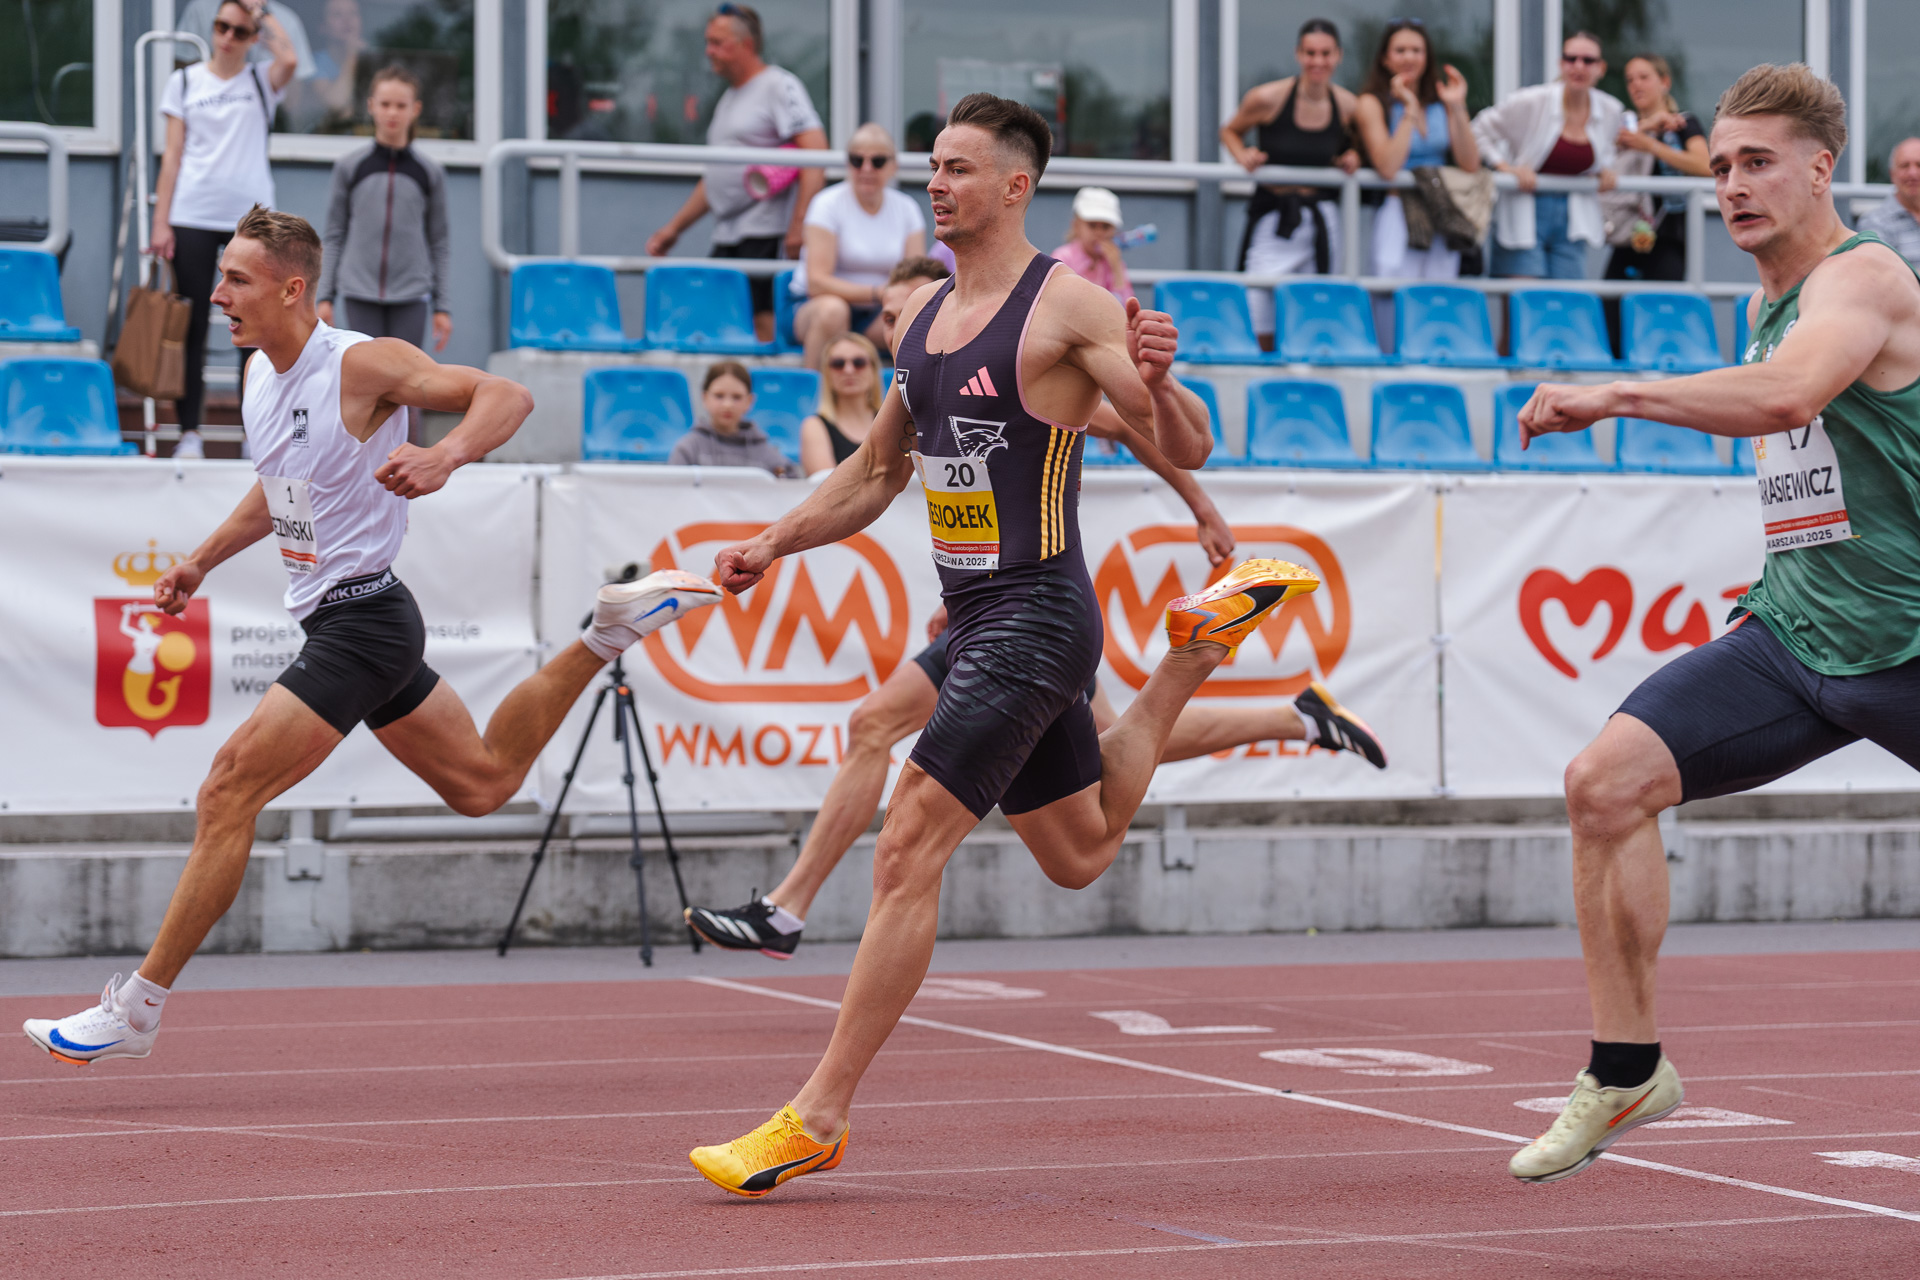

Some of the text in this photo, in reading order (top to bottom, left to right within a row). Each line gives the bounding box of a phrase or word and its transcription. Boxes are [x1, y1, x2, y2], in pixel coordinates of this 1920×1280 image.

[944, 463, 975, 487] 20
[286, 485, 294, 503] 1
[1806, 529, 1833, 543] 2025
[966, 557, 987, 566] 2025
[326, 578, 383, 602] WK DZIK
